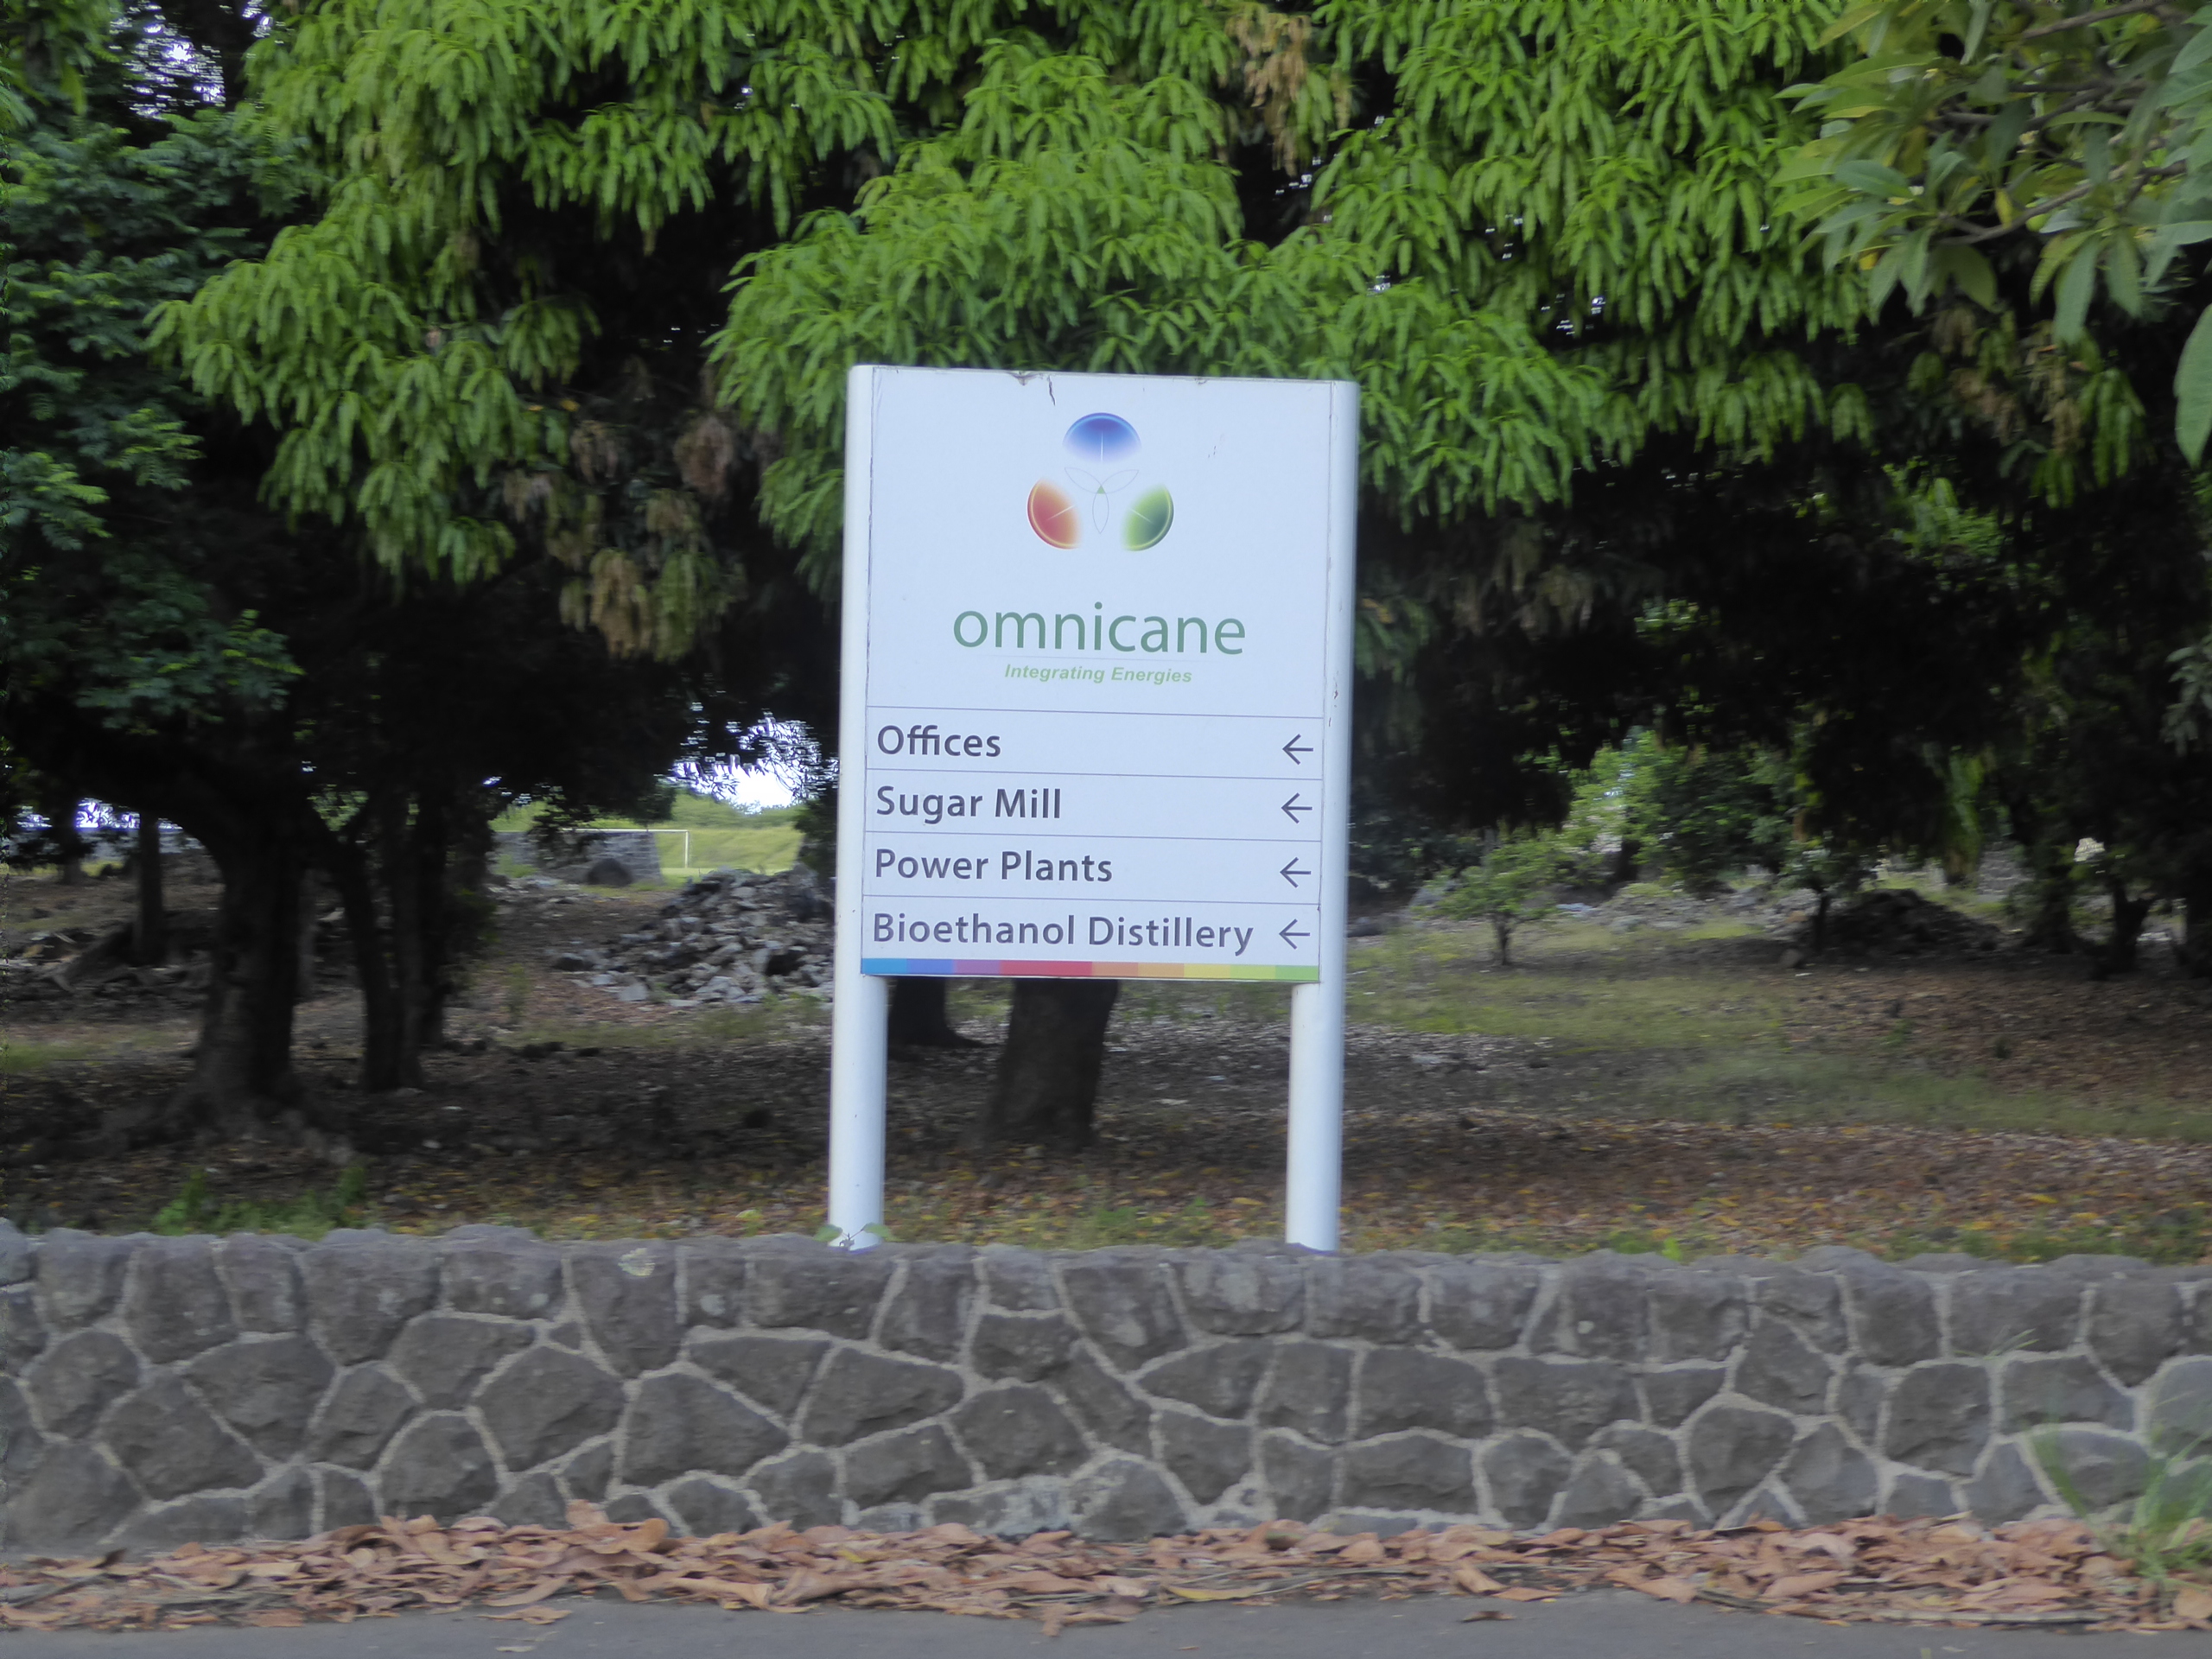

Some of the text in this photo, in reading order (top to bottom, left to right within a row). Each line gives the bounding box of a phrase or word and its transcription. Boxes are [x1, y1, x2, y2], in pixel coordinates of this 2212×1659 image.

[953, 601, 1246, 655] omnicane
[1004, 664, 1192, 685] Integrating Energies
[877, 724, 1001, 758] Offices
[876, 785, 1061, 825] Sugar Mill
[875, 849, 1112, 882] Power Plants
[874, 912, 1254, 957] Bioethanol Distillery
